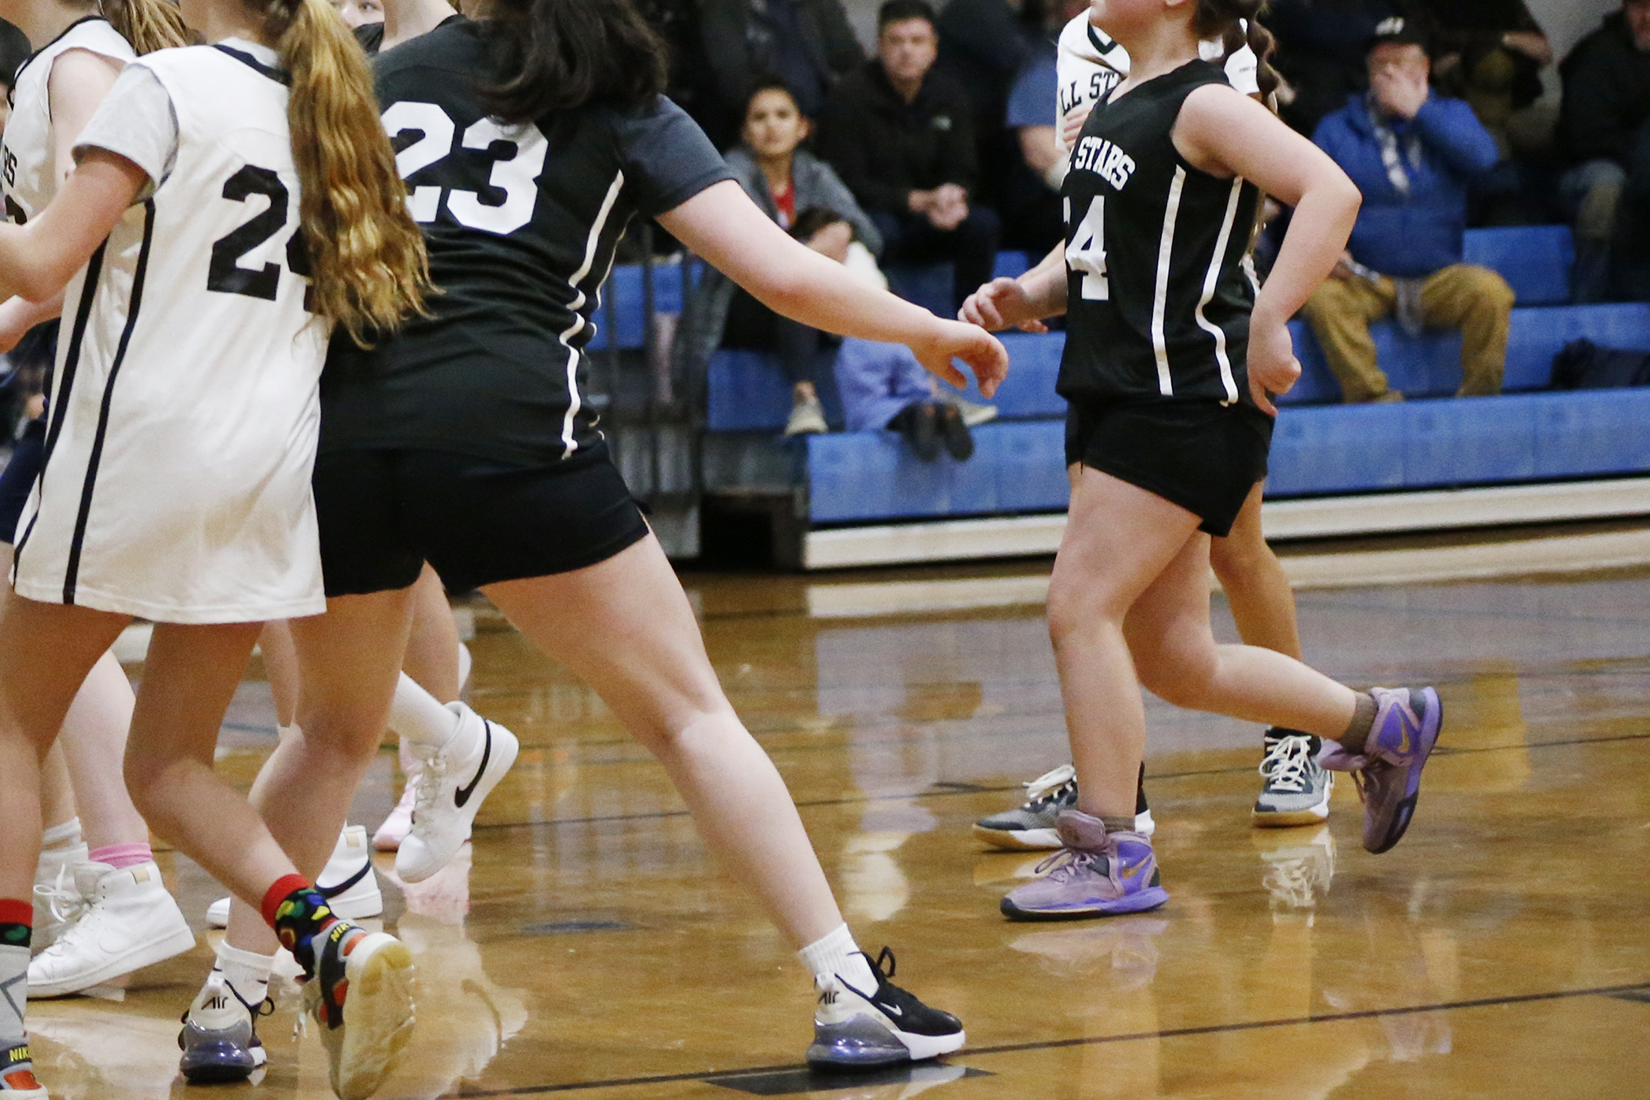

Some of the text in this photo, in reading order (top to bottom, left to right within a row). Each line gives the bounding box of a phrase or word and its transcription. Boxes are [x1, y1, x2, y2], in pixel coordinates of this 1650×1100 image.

[1060, 80, 1082, 117] LL
[380, 101, 549, 235] 23
[1075, 136, 1136, 191] STARS
[207, 164, 316, 314] 2
[1063, 195, 1109, 300] 4
[330, 923, 350, 942] NIK
[9, 1046, 31, 1062] NIK
